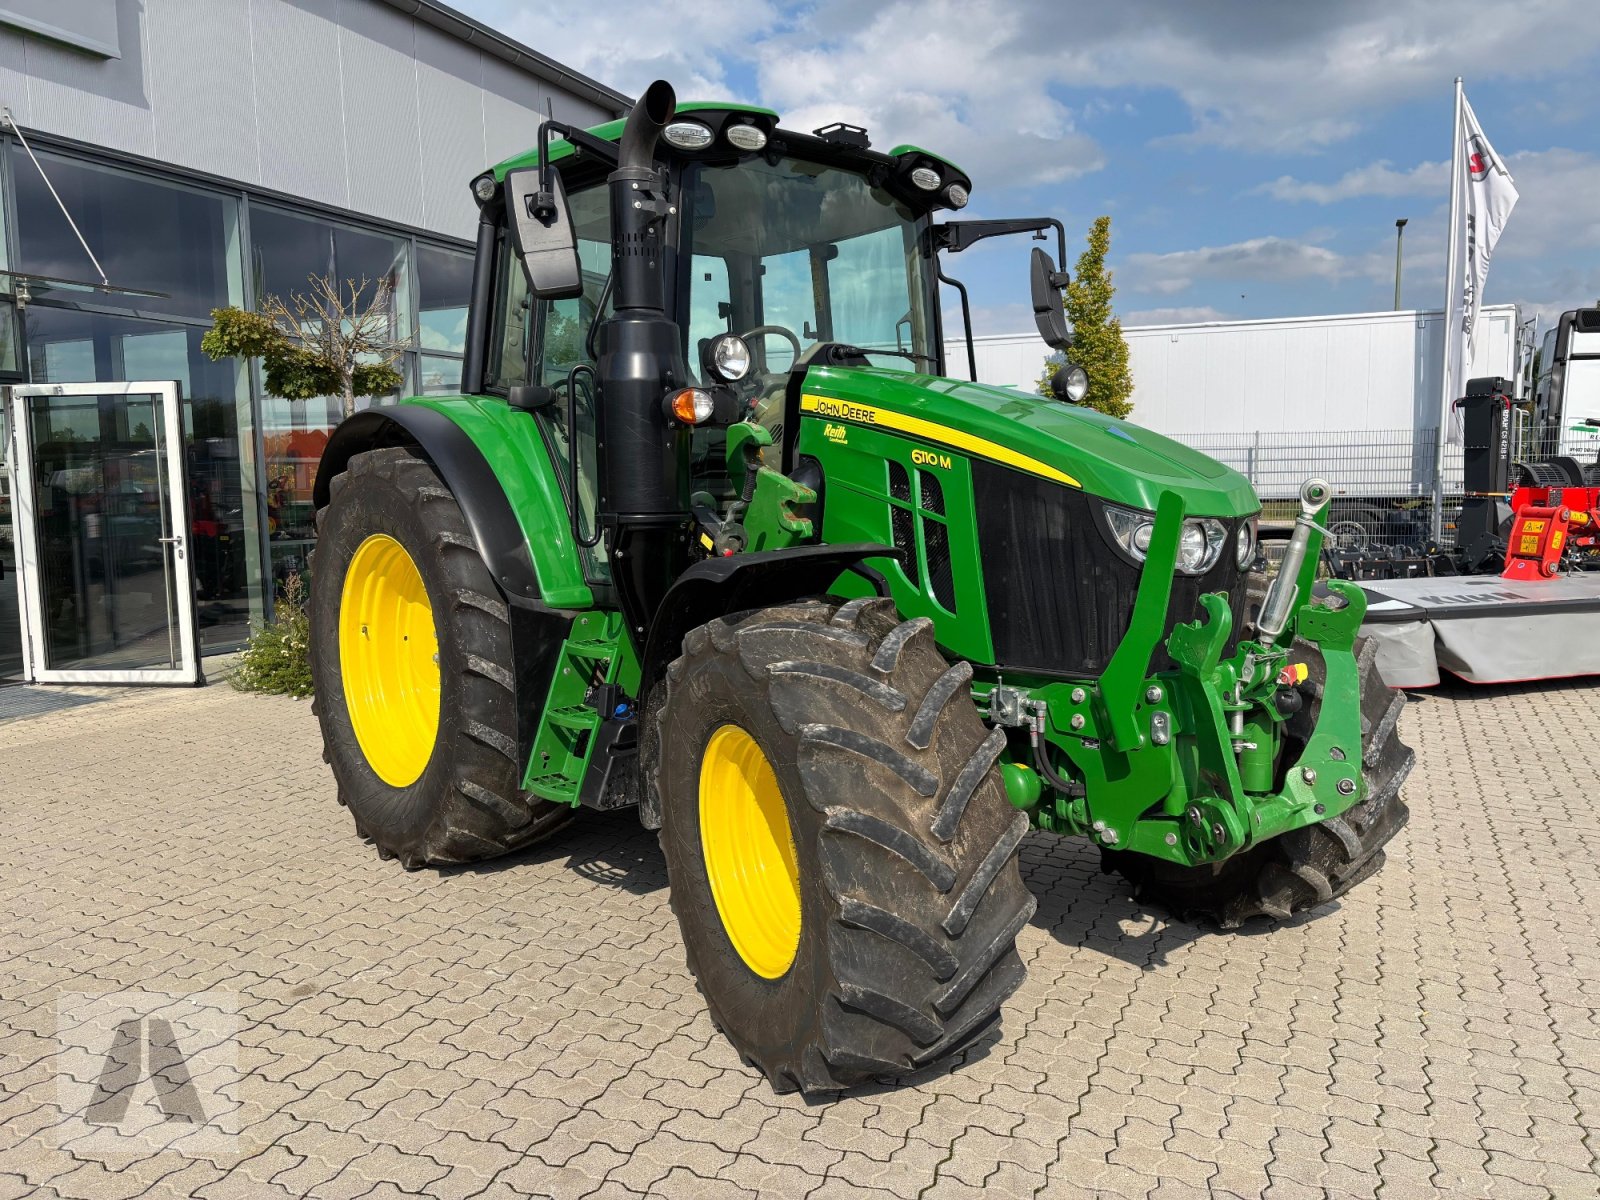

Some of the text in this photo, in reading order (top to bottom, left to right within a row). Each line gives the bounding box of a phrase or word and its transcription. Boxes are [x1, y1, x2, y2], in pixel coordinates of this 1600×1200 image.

[814, 399, 876, 422] JOHN DEERE
[824, 424, 846, 439] Reith
[911, 449, 952, 471] 6110 M
